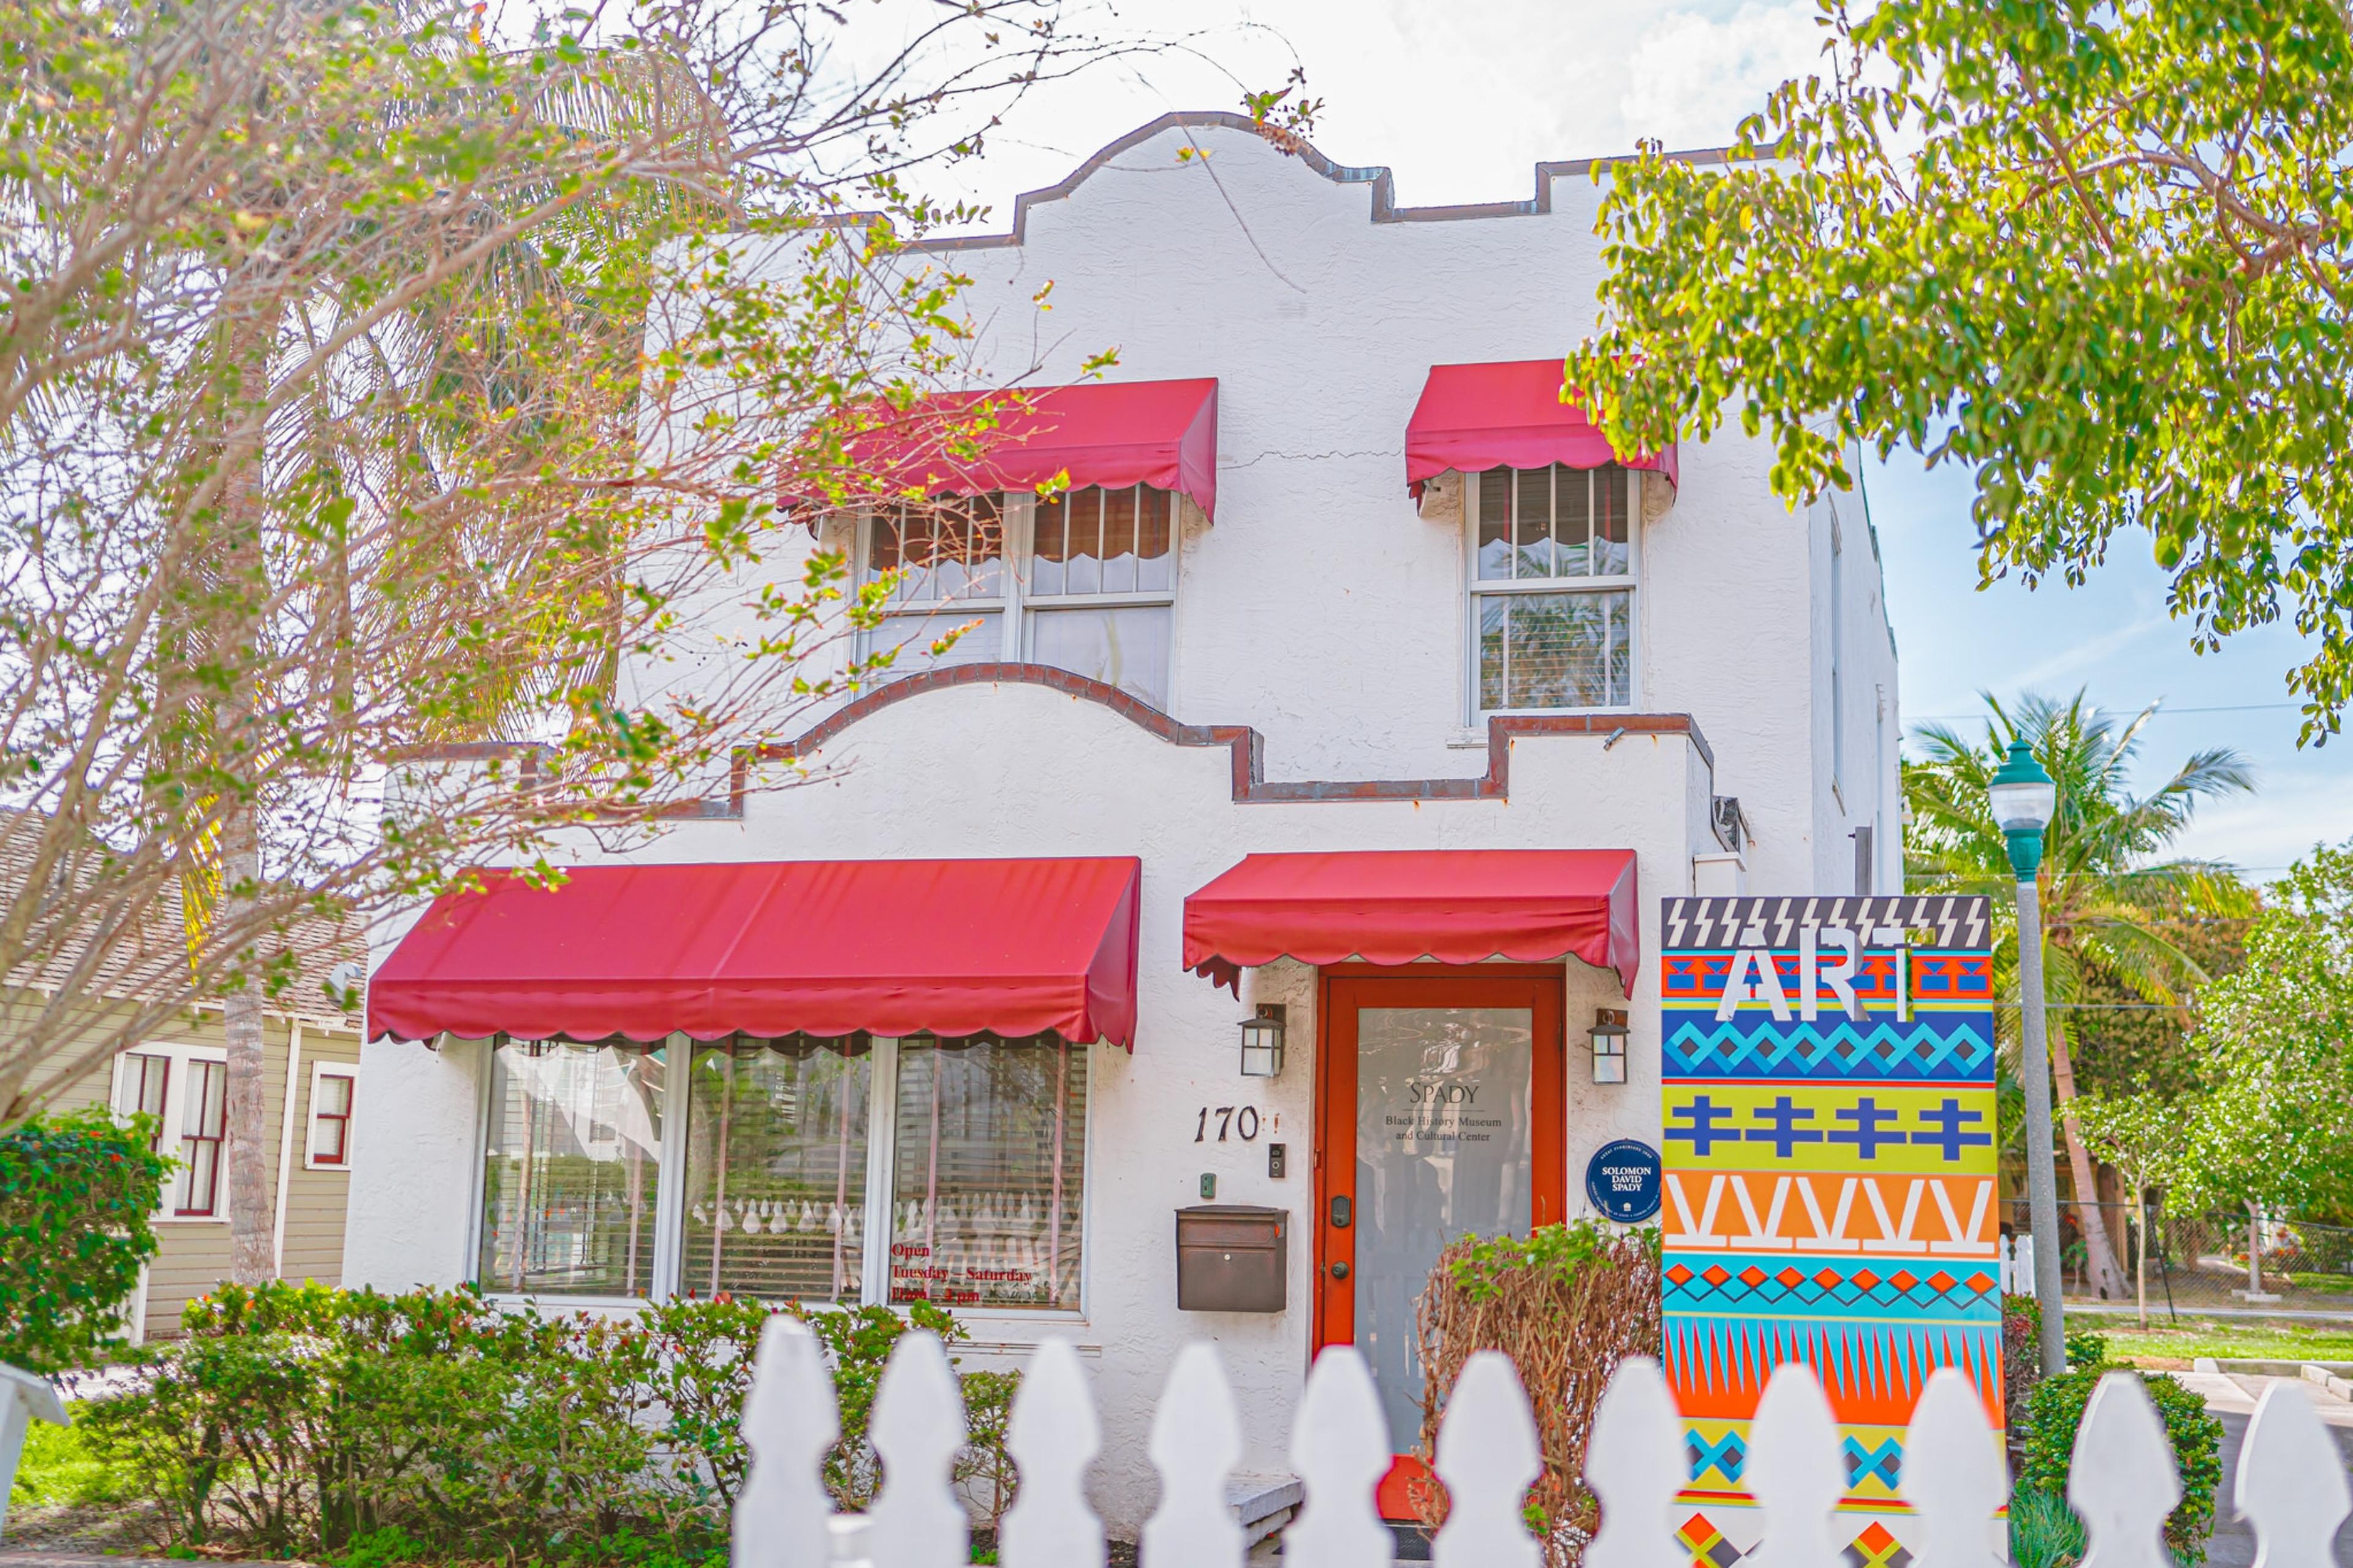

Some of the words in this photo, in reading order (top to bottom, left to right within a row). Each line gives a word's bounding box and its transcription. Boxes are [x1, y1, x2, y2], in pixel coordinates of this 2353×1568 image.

[1715, 927, 1936, 1023] ART
[1410, 1082, 1479, 1104] SPADY
[1194, 1105, 1259, 1142] 170
[1385, 1116, 1413, 1125] Black
[1418, 1116, 1454, 1127] History
[1458, 1118, 1502, 1127] Museum
[1396, 1131, 1412, 1140] and
[1417, 1132, 1455, 1140] Cultural
[1458, 1132, 1490, 1141] Center
[1602, 1167, 1651, 1175] SOLOMON
[1612, 1183, 1642, 1192] SPADY
[892, 1243, 930, 1260] Open
[892, 1265, 949, 1282] Tuesday
[966, 1267, 1033, 1284] Saturday
